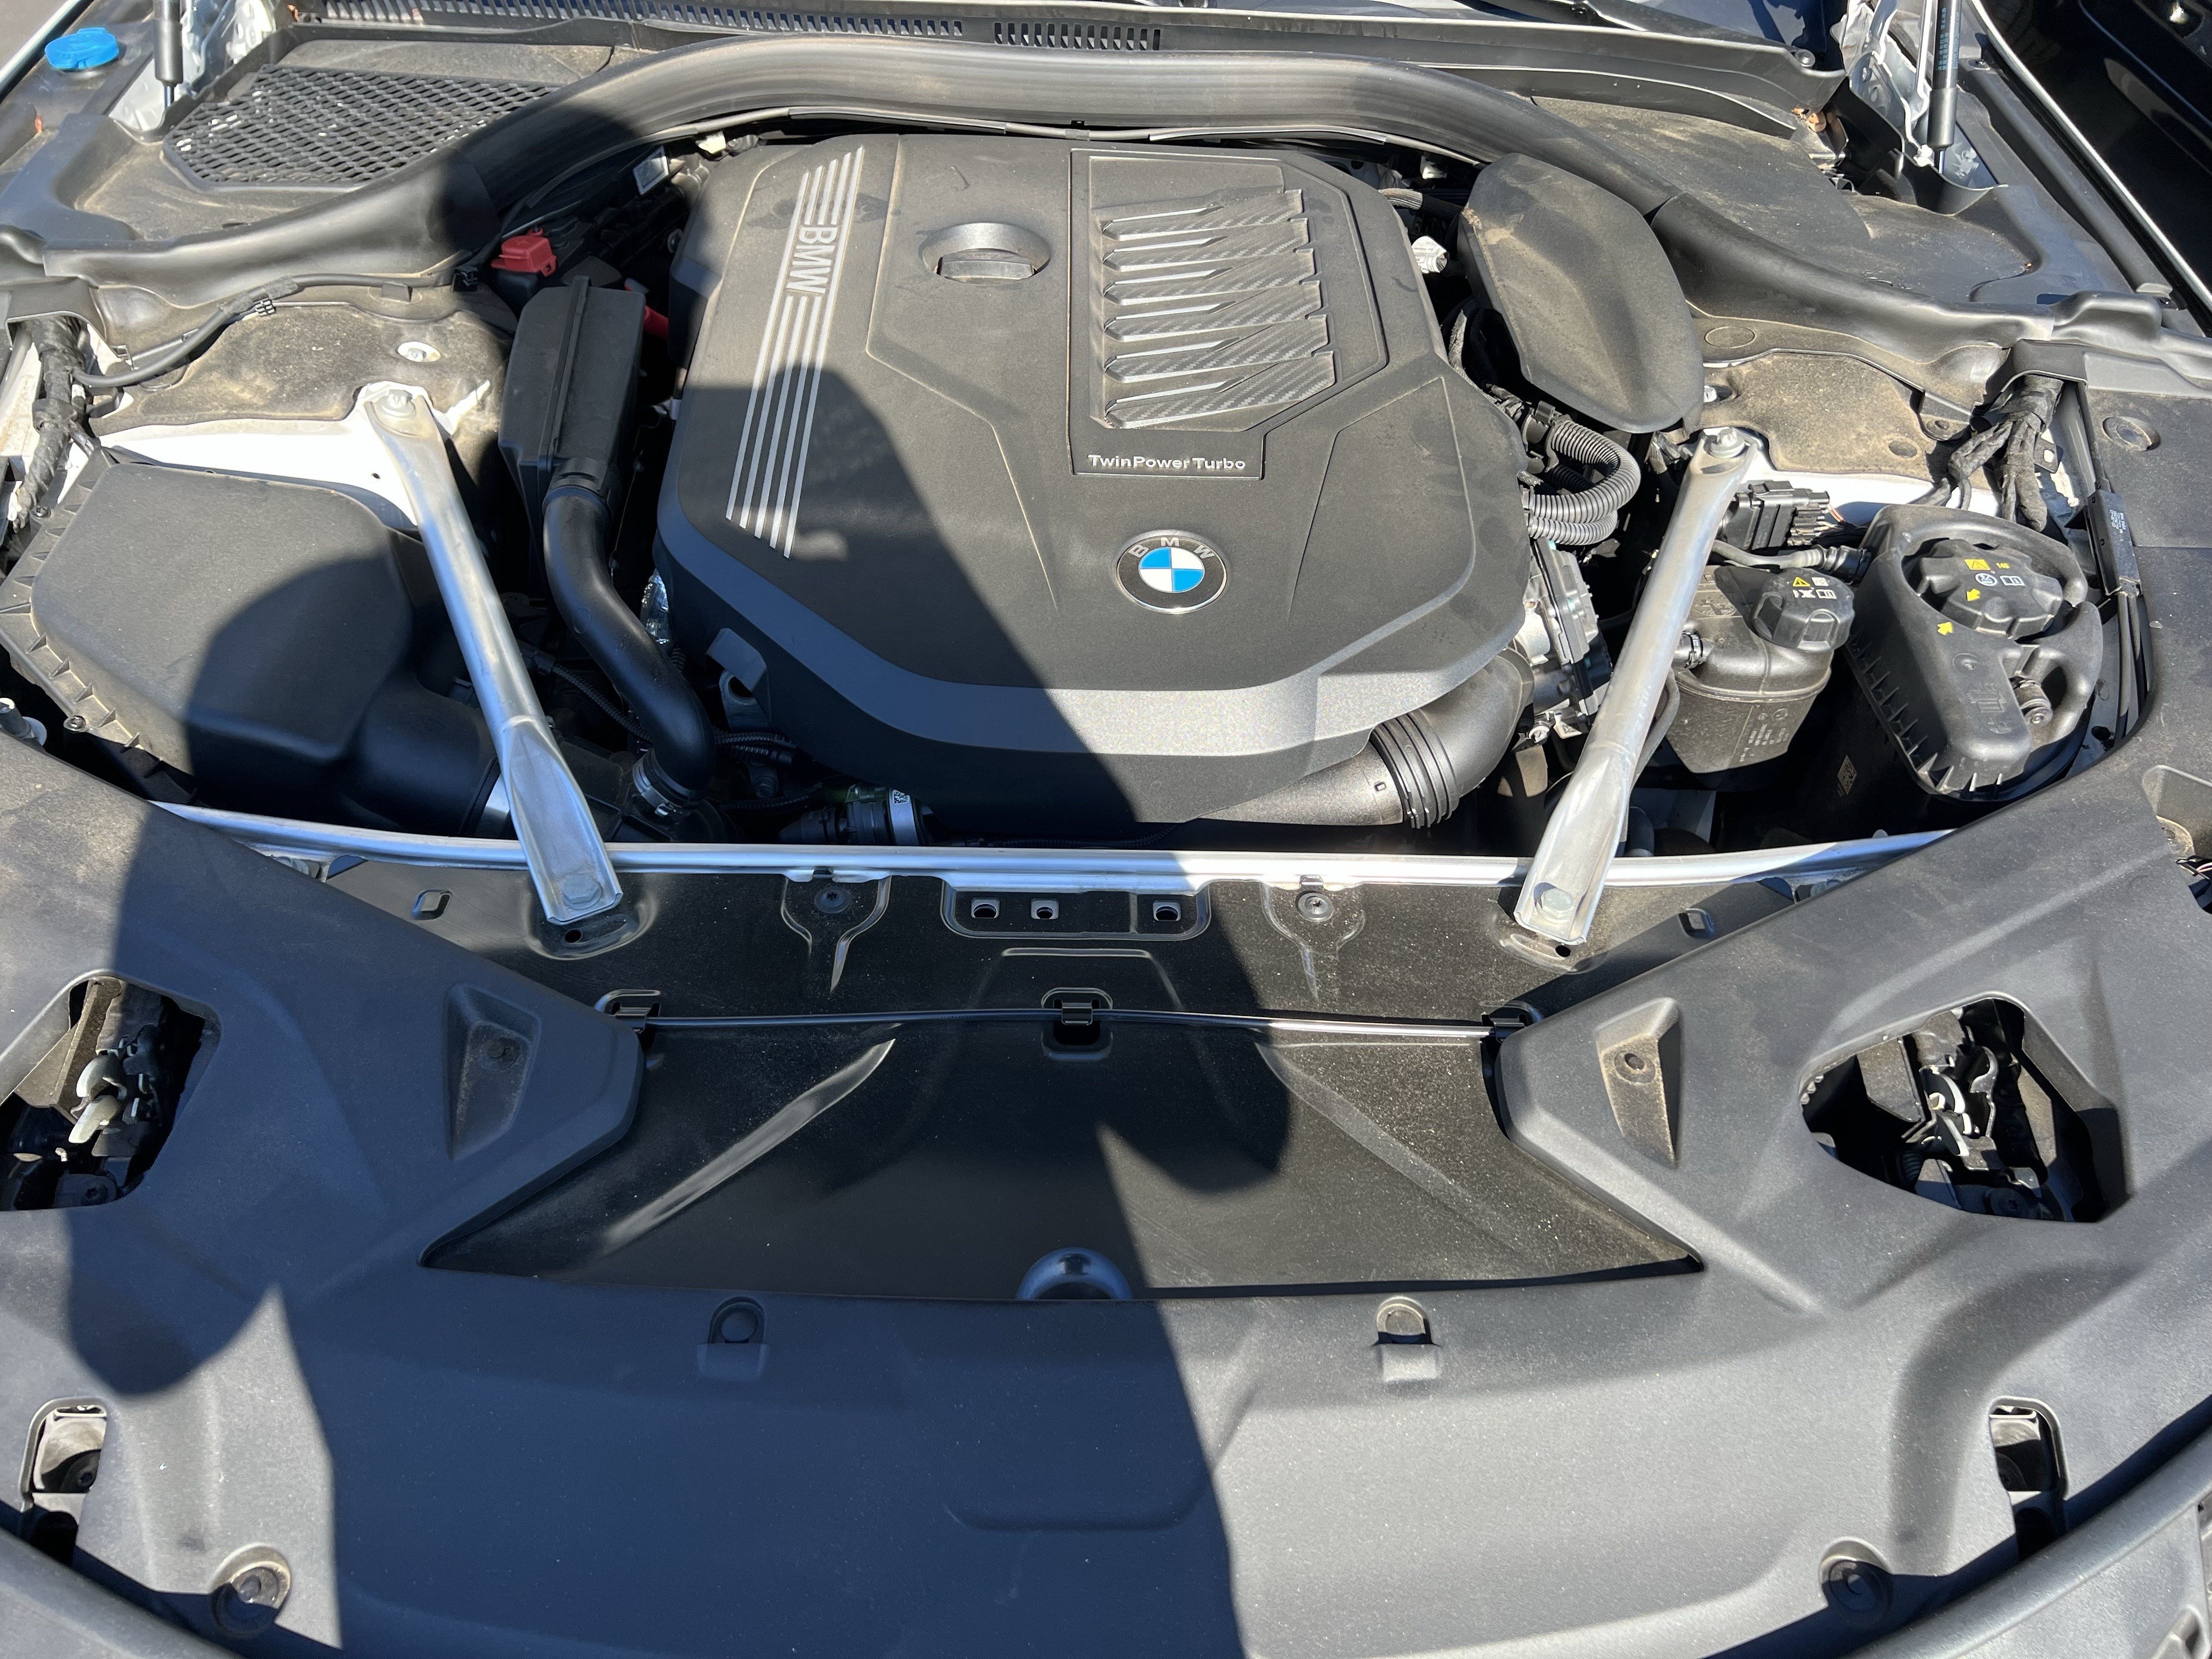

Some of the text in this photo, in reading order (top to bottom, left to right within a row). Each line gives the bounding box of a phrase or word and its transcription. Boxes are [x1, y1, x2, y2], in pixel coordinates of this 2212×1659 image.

[786, 227, 838, 294] BMW
[1088, 454, 1246, 470] TwinPower Turbo
[1128, 537, 1215, 558] BMW
